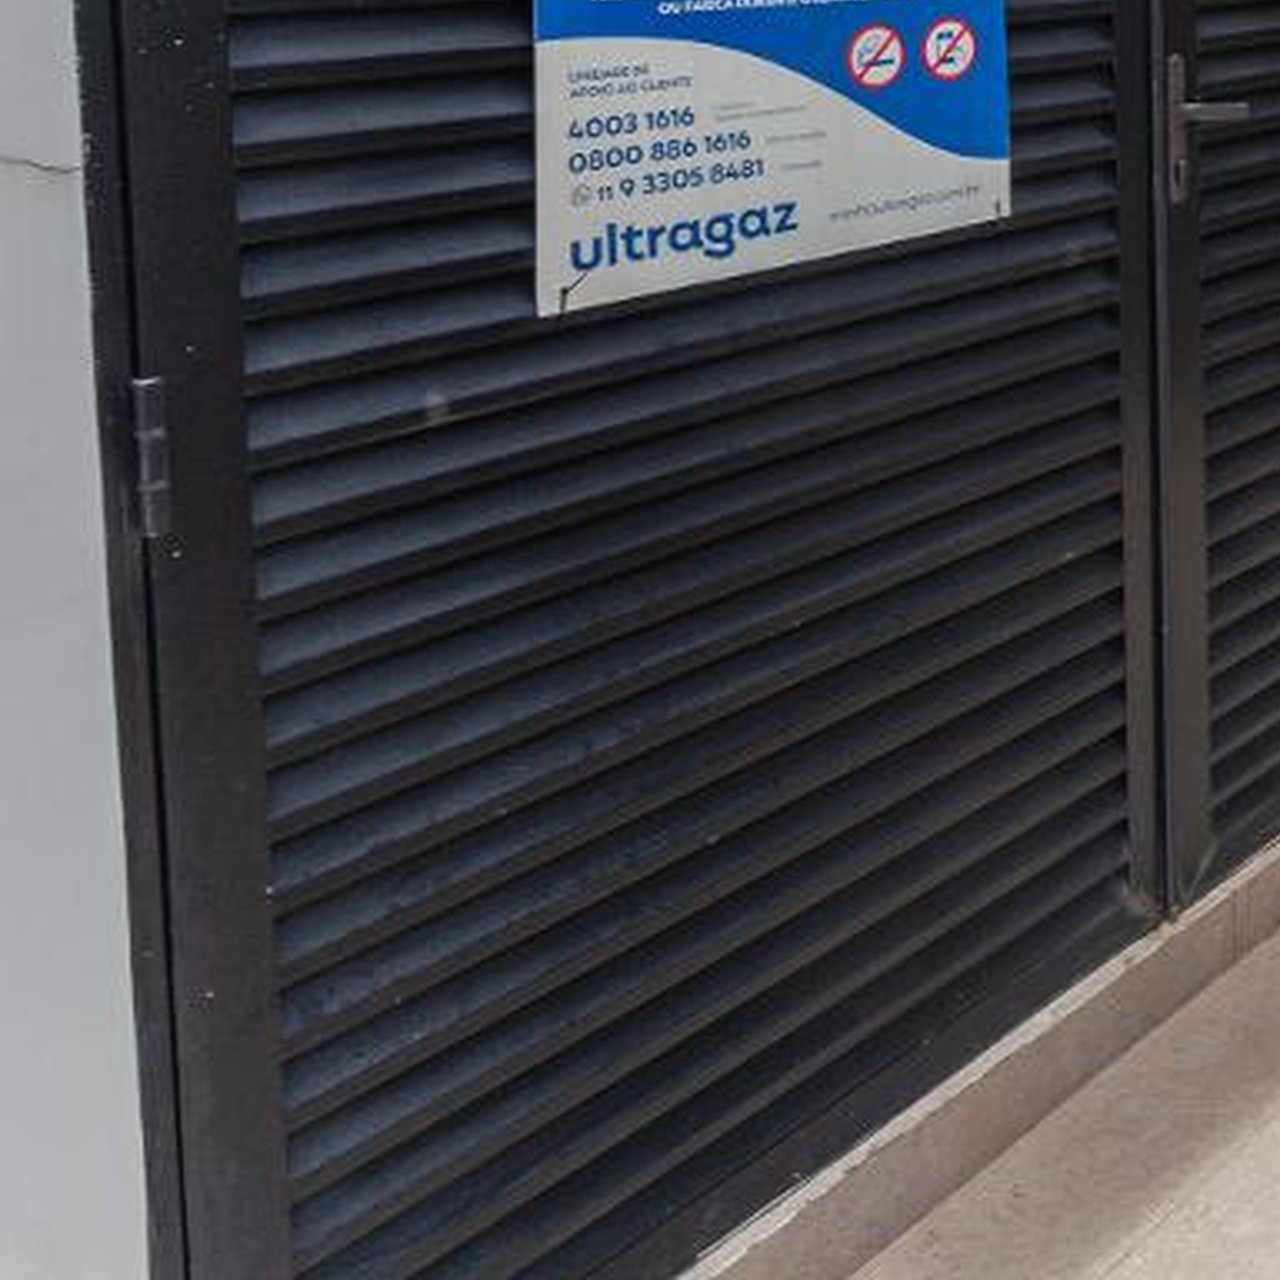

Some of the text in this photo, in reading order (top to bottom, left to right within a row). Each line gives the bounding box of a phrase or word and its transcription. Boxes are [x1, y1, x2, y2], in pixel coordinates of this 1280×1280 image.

[568, 114, 638, 138] 4003
[644, 107, 695, 131] 1616
[568, 146, 643, 173] 0800
[650, 140, 697, 161] 886
[705, 131, 751, 154] 1616
[598, 185, 613, 202] 11
[620, 178, 634, 197] 9
[642, 168, 704, 195] 3305
[710, 159, 764, 184] 8481
[570, 202, 799, 271] ultragaz
